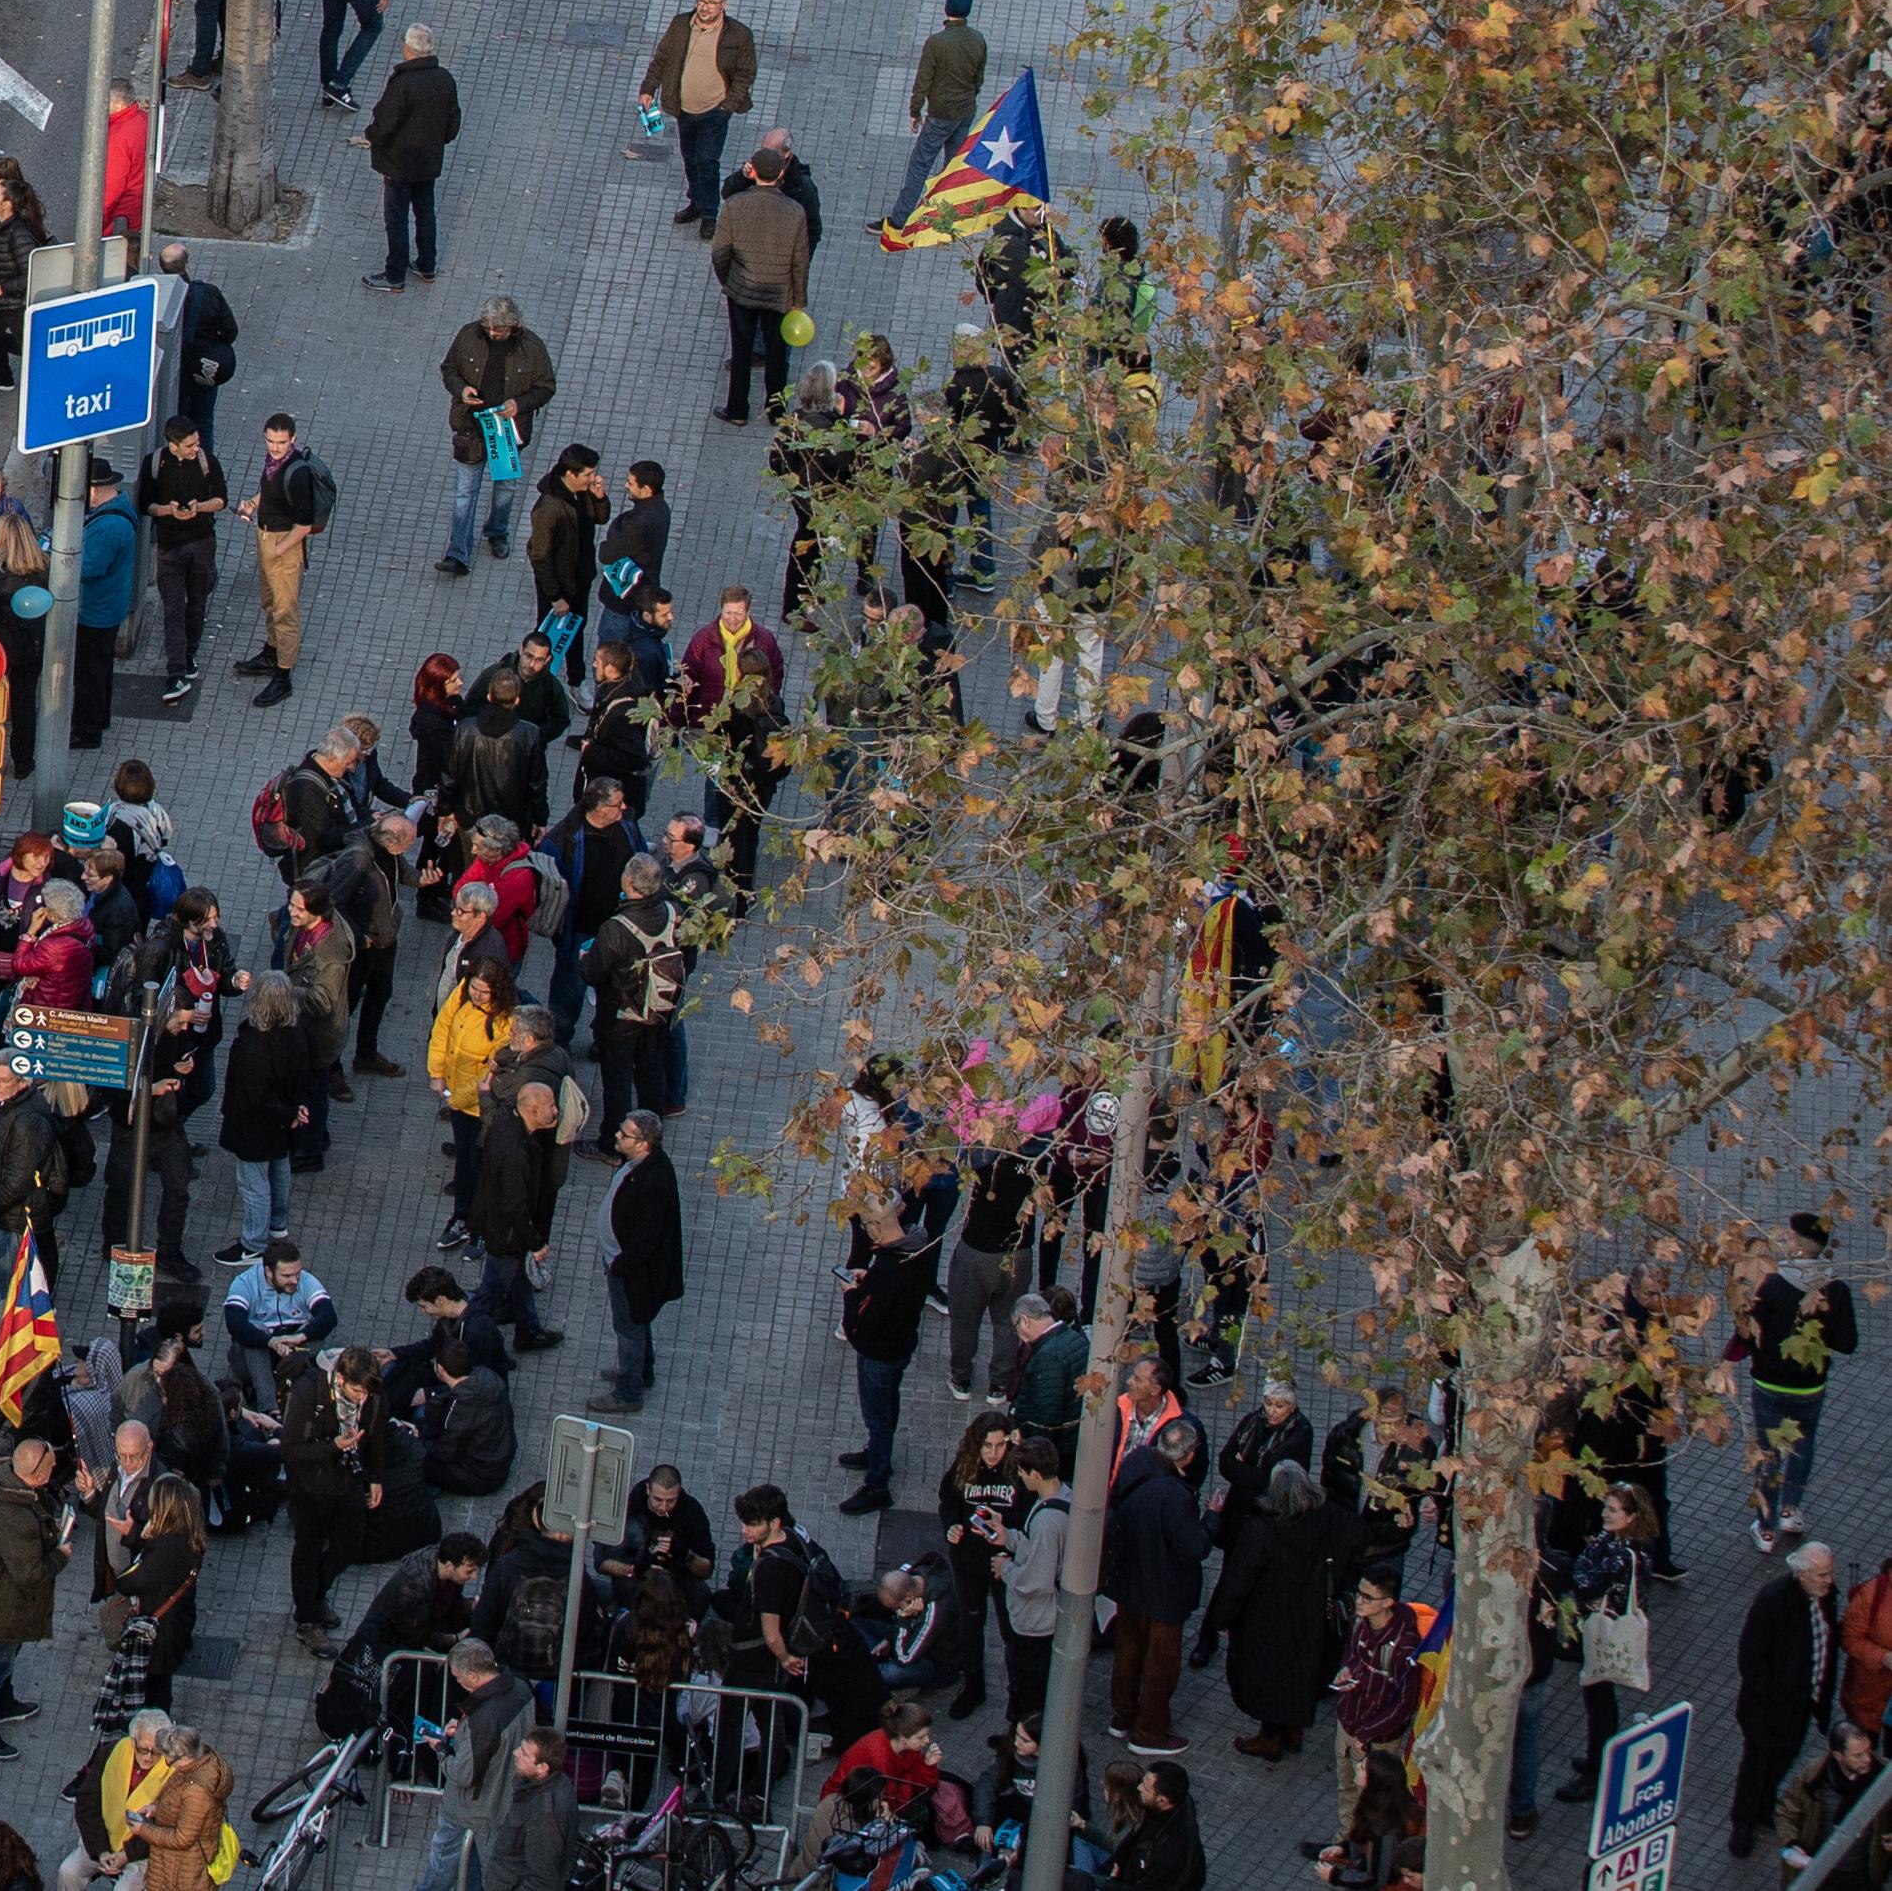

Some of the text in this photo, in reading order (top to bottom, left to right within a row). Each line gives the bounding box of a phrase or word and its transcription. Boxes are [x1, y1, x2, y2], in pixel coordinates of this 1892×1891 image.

[64, 383, 113, 420] taxi
[69, 816, 87, 830] AND
[605, 1733, 616, 1743] de
[616, 1734, 656, 1747] Barcelona
[1619, 1734, 1670, 1815] P
[1635, 1781, 1665, 1807] FCB
[1601, 1796, 1676, 1850] Abonats
[1620, 1838, 1666, 1879] A B
